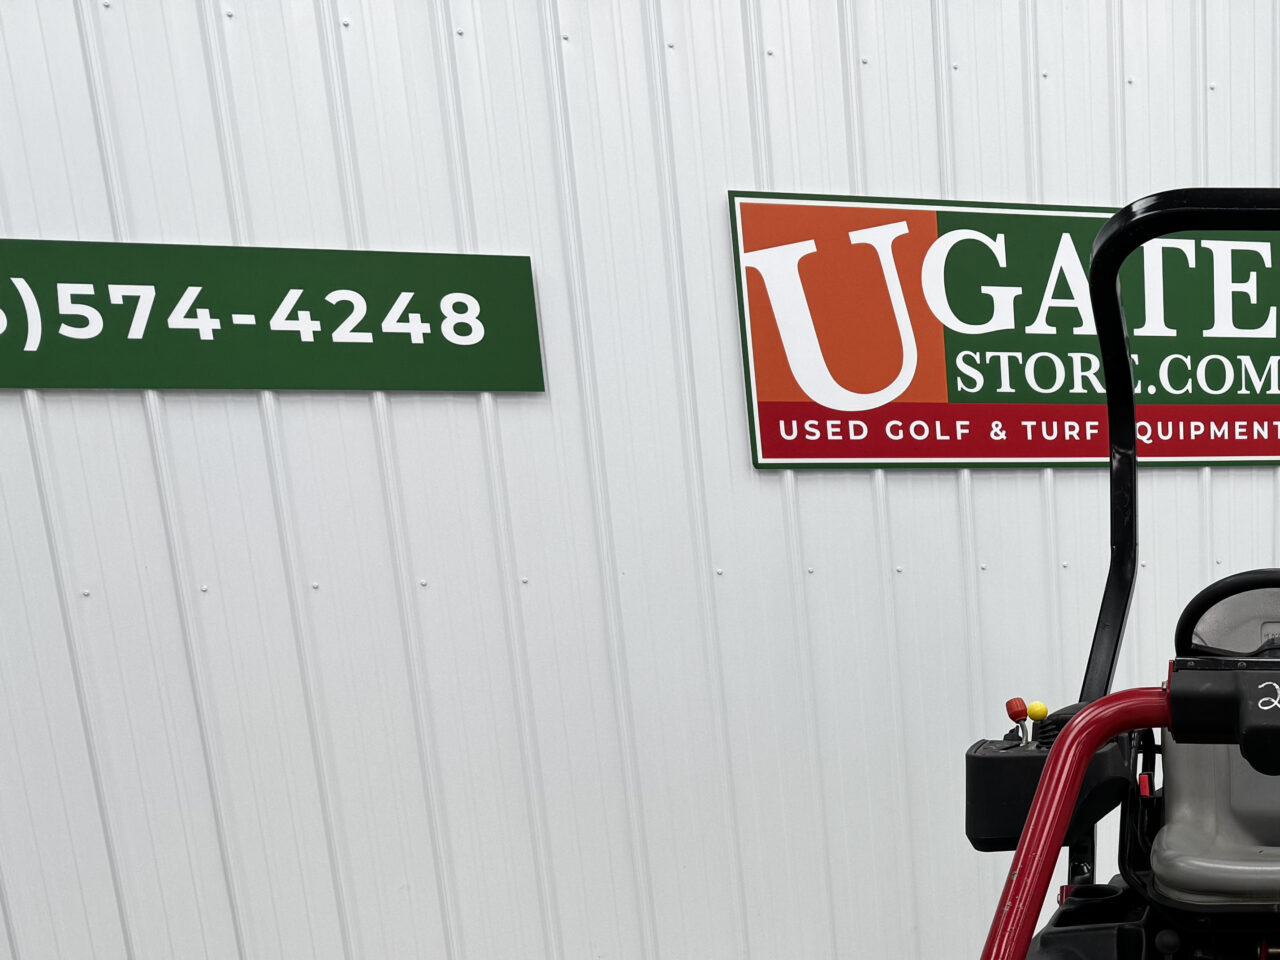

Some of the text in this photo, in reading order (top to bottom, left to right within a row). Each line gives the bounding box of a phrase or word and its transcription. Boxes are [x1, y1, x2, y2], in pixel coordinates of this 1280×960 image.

[0, 277, 485, 352] )574-4248
[744, 220, 1277, 412] UGATE
[779, 420, 869, 441] USED
[885, 420, 971, 441] GOLF
[990, 420, 1007, 441] &
[1021, 420, 1099, 441] TURF
